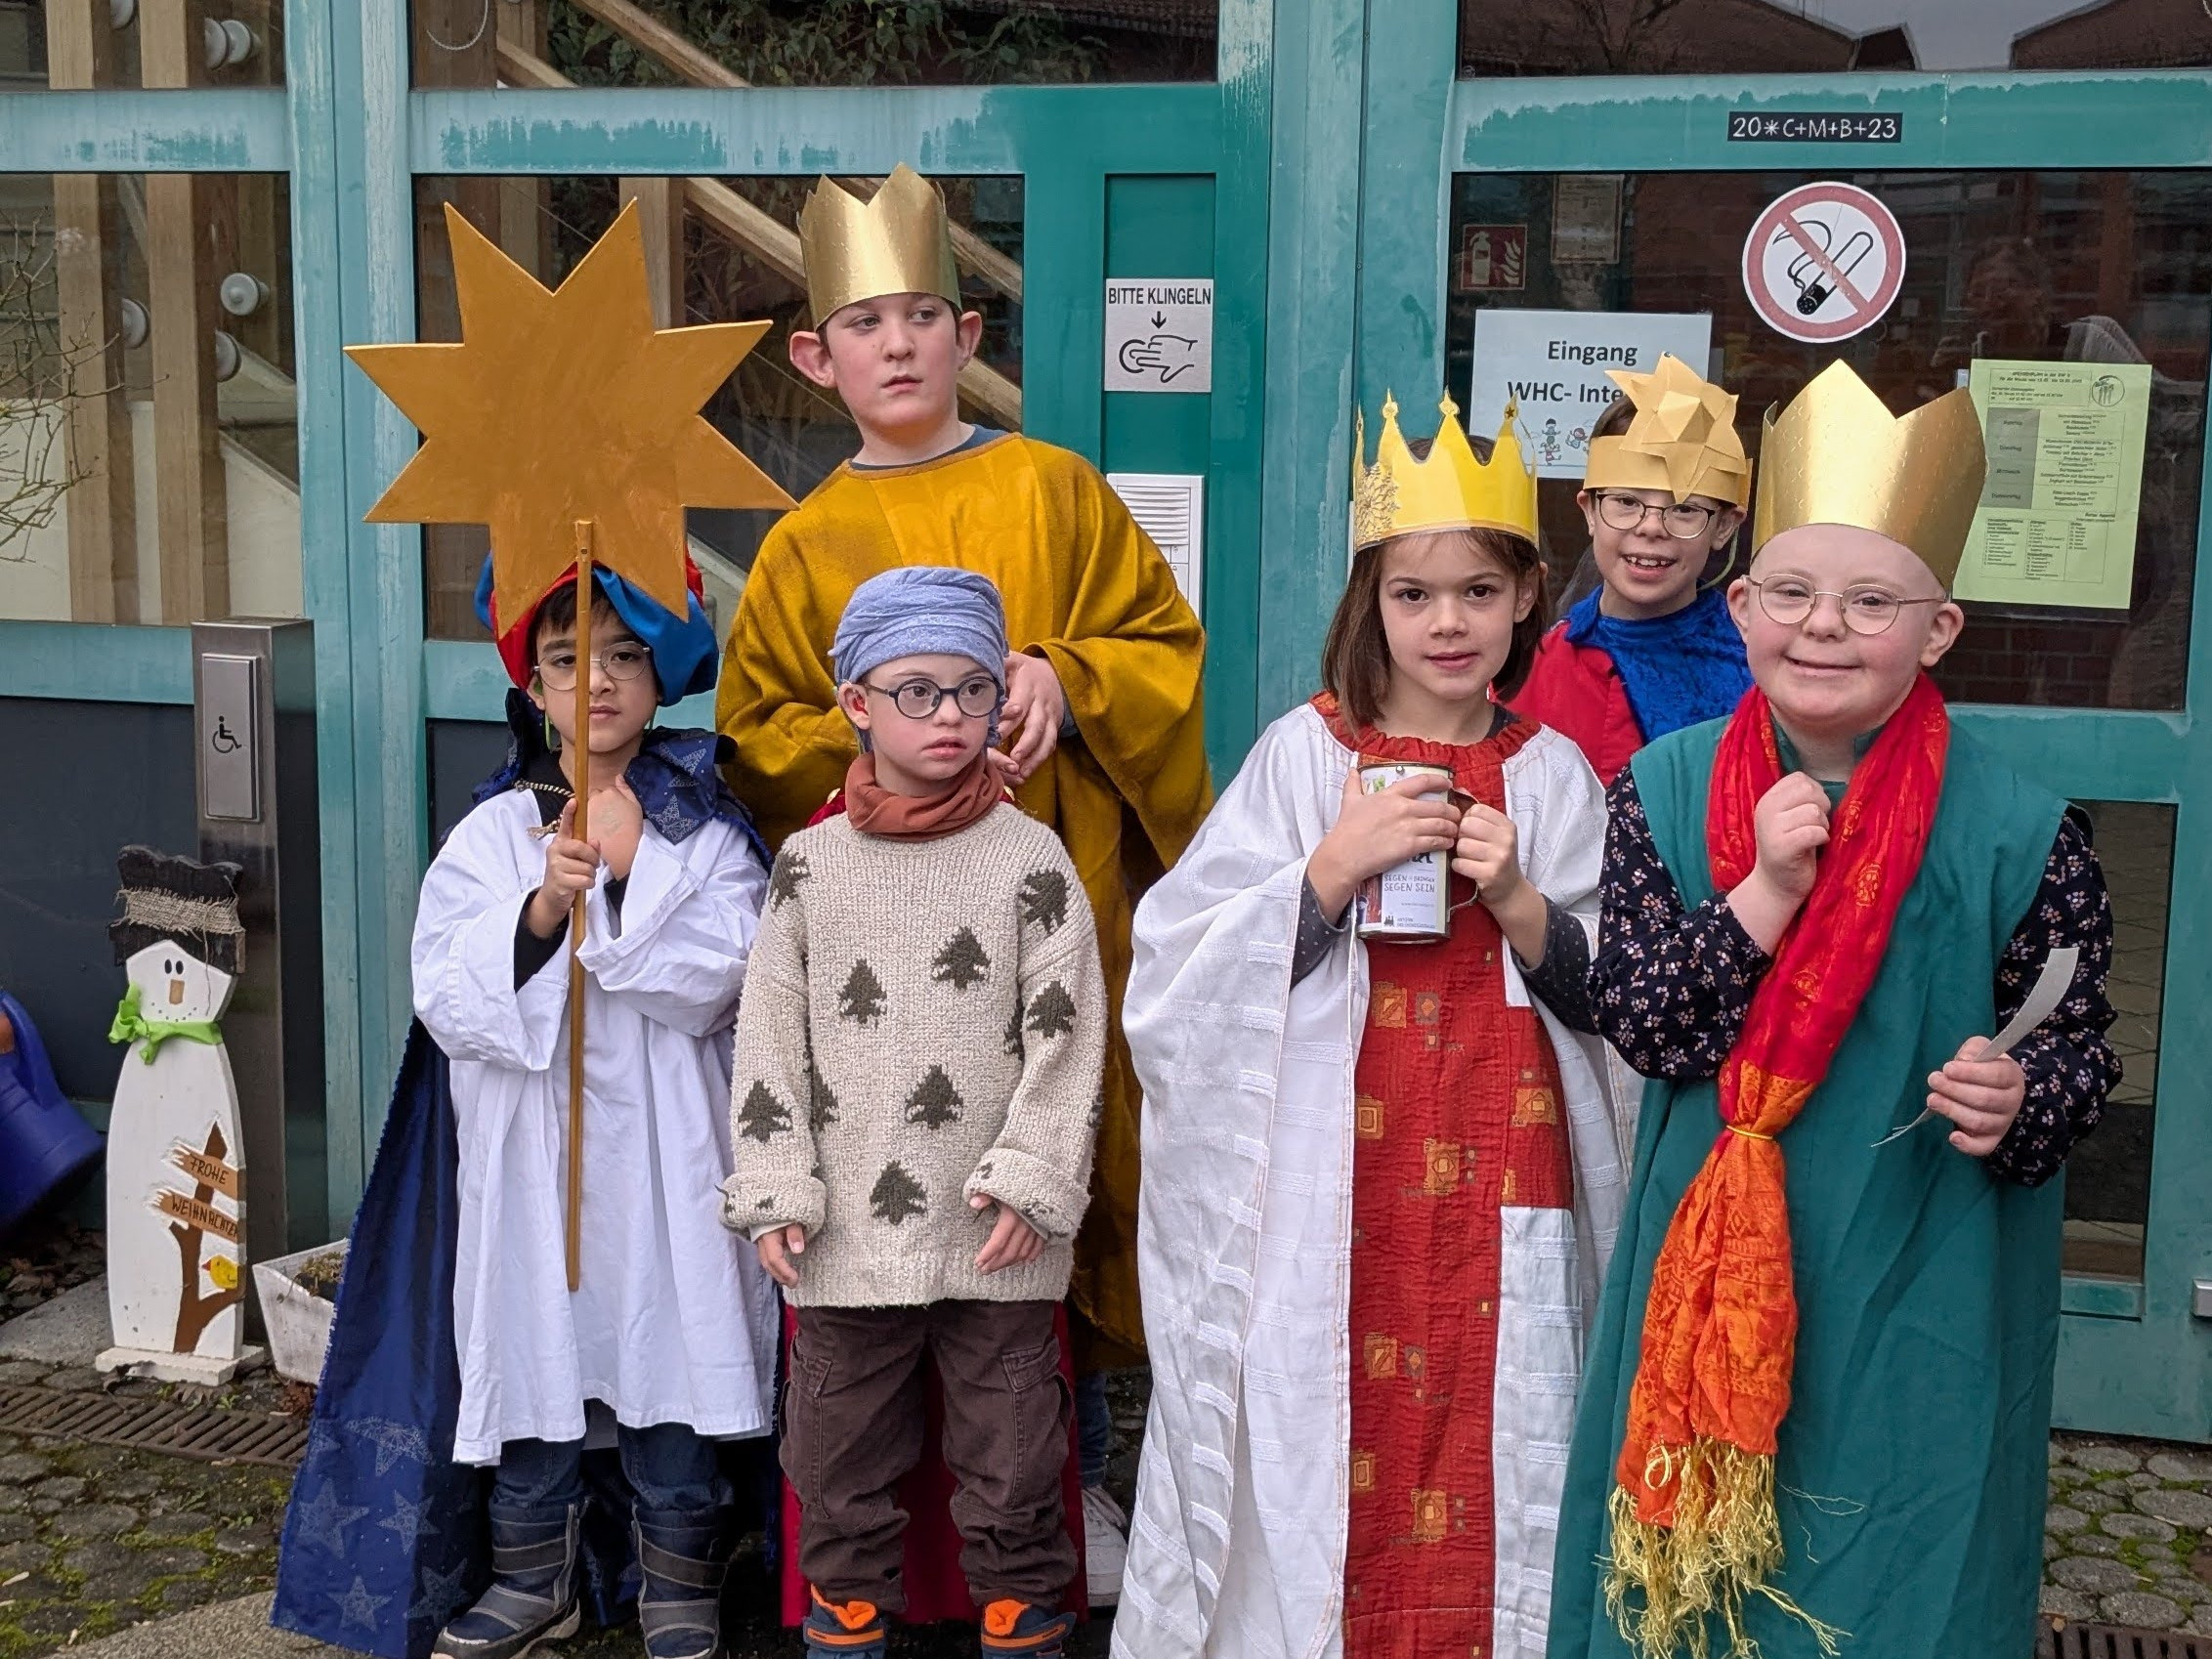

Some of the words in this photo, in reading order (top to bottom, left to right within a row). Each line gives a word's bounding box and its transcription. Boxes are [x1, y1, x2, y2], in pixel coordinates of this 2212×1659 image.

[1108, 287, 1144, 305] BITTE
[1147, 287, 1212, 305] KLINGELN
[1548, 340, 1638, 366] Eingang
[1508, 381, 1571, 403] WHC-
[1383, 882, 1413, 892] SEGEN
[1415, 882, 1435, 893] SEIN
[190, 1154, 230, 1185] FROHE
